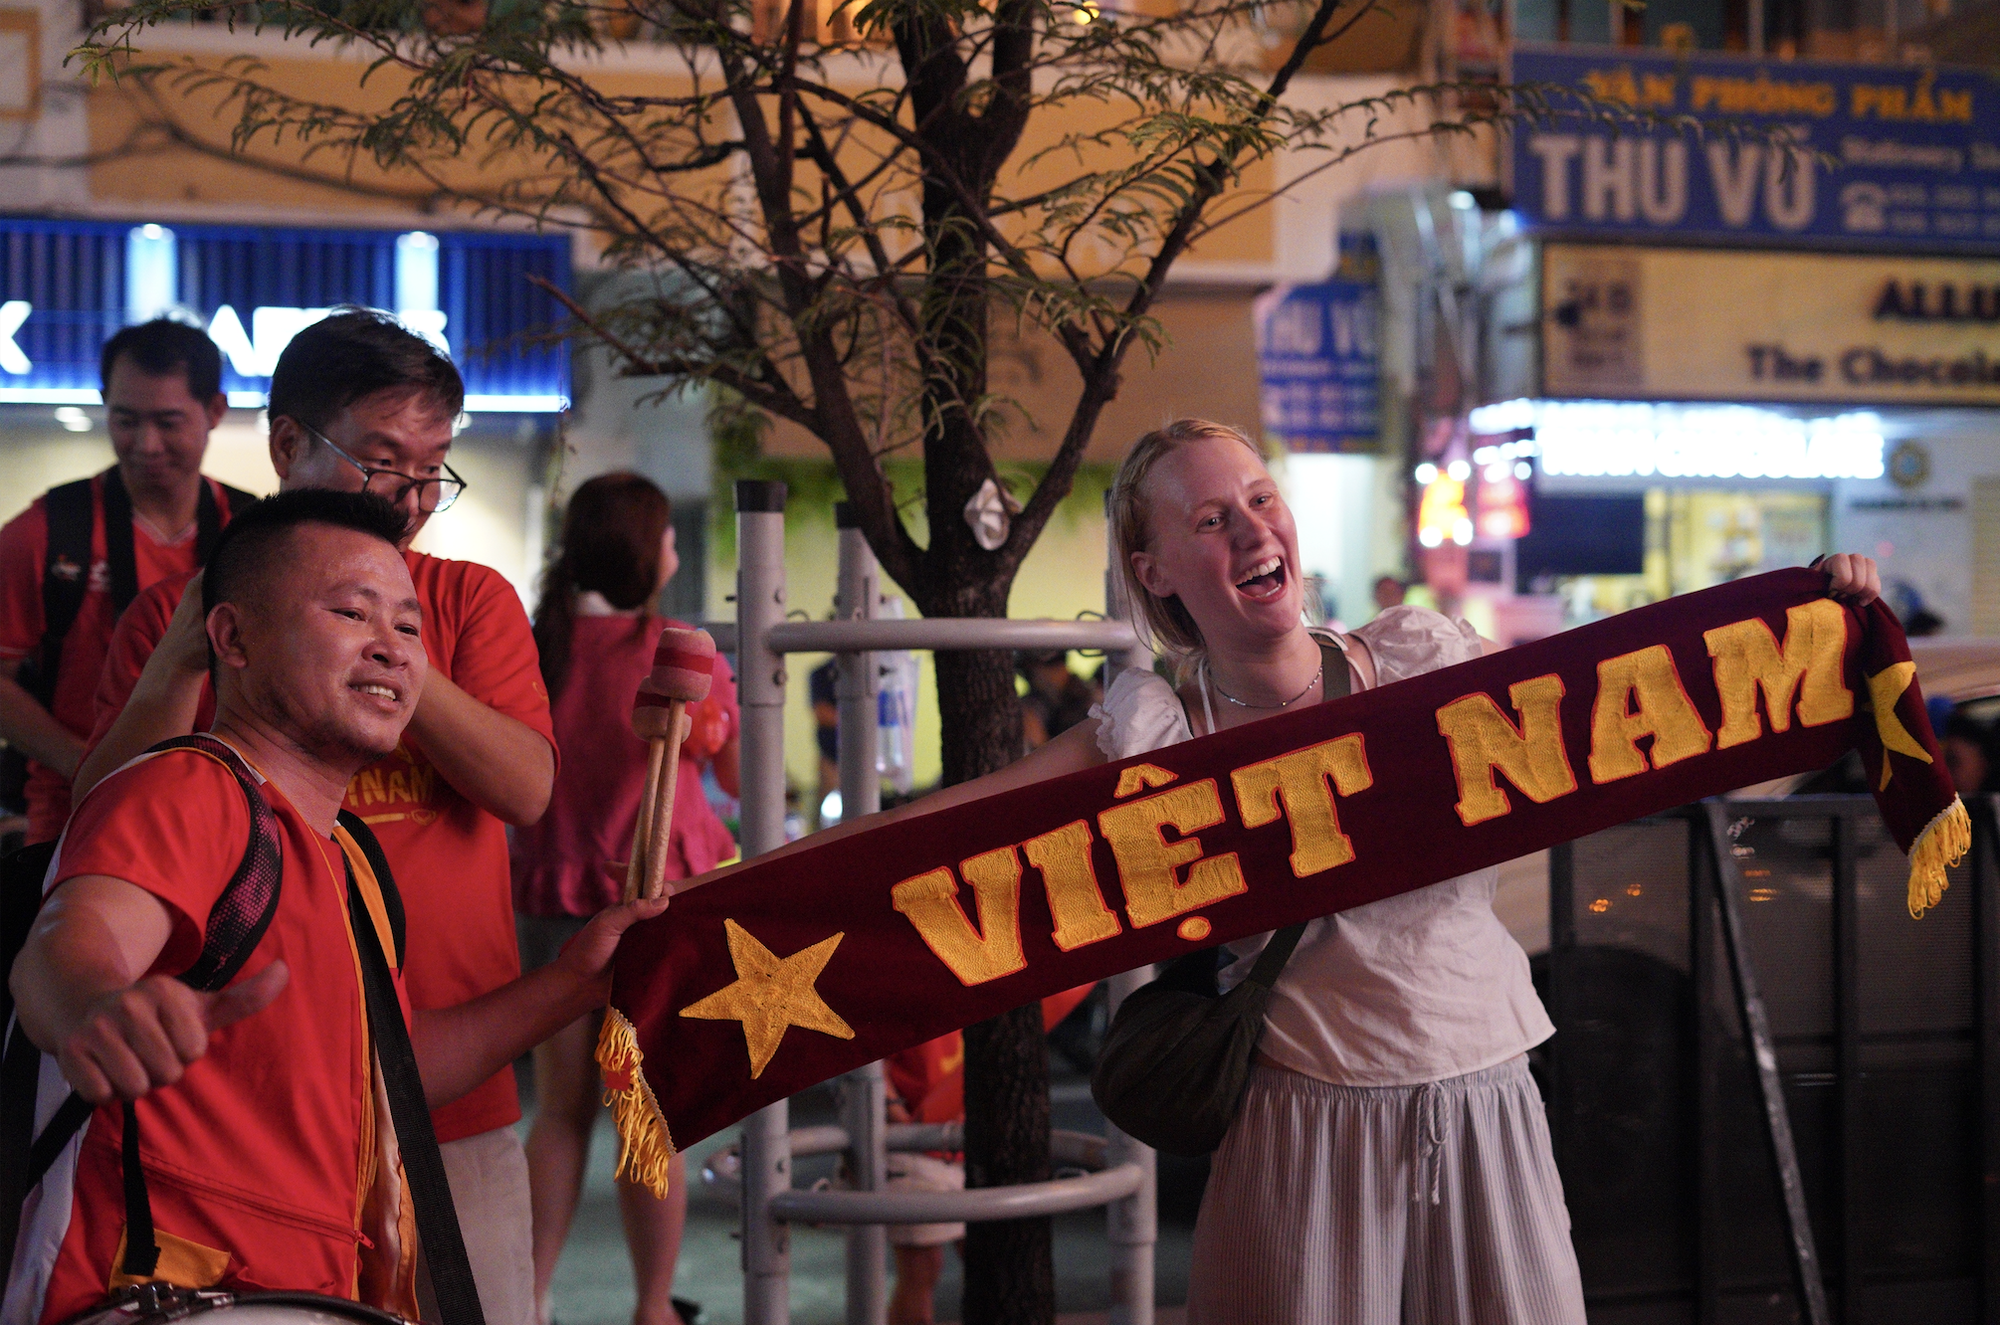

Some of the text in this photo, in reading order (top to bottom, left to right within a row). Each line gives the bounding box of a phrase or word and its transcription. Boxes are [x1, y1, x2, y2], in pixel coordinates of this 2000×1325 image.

[1528, 133, 1688, 225] THU
[1745, 343, 1823, 383] The
[891, 598, 1854, 987] VIỆT NAM
